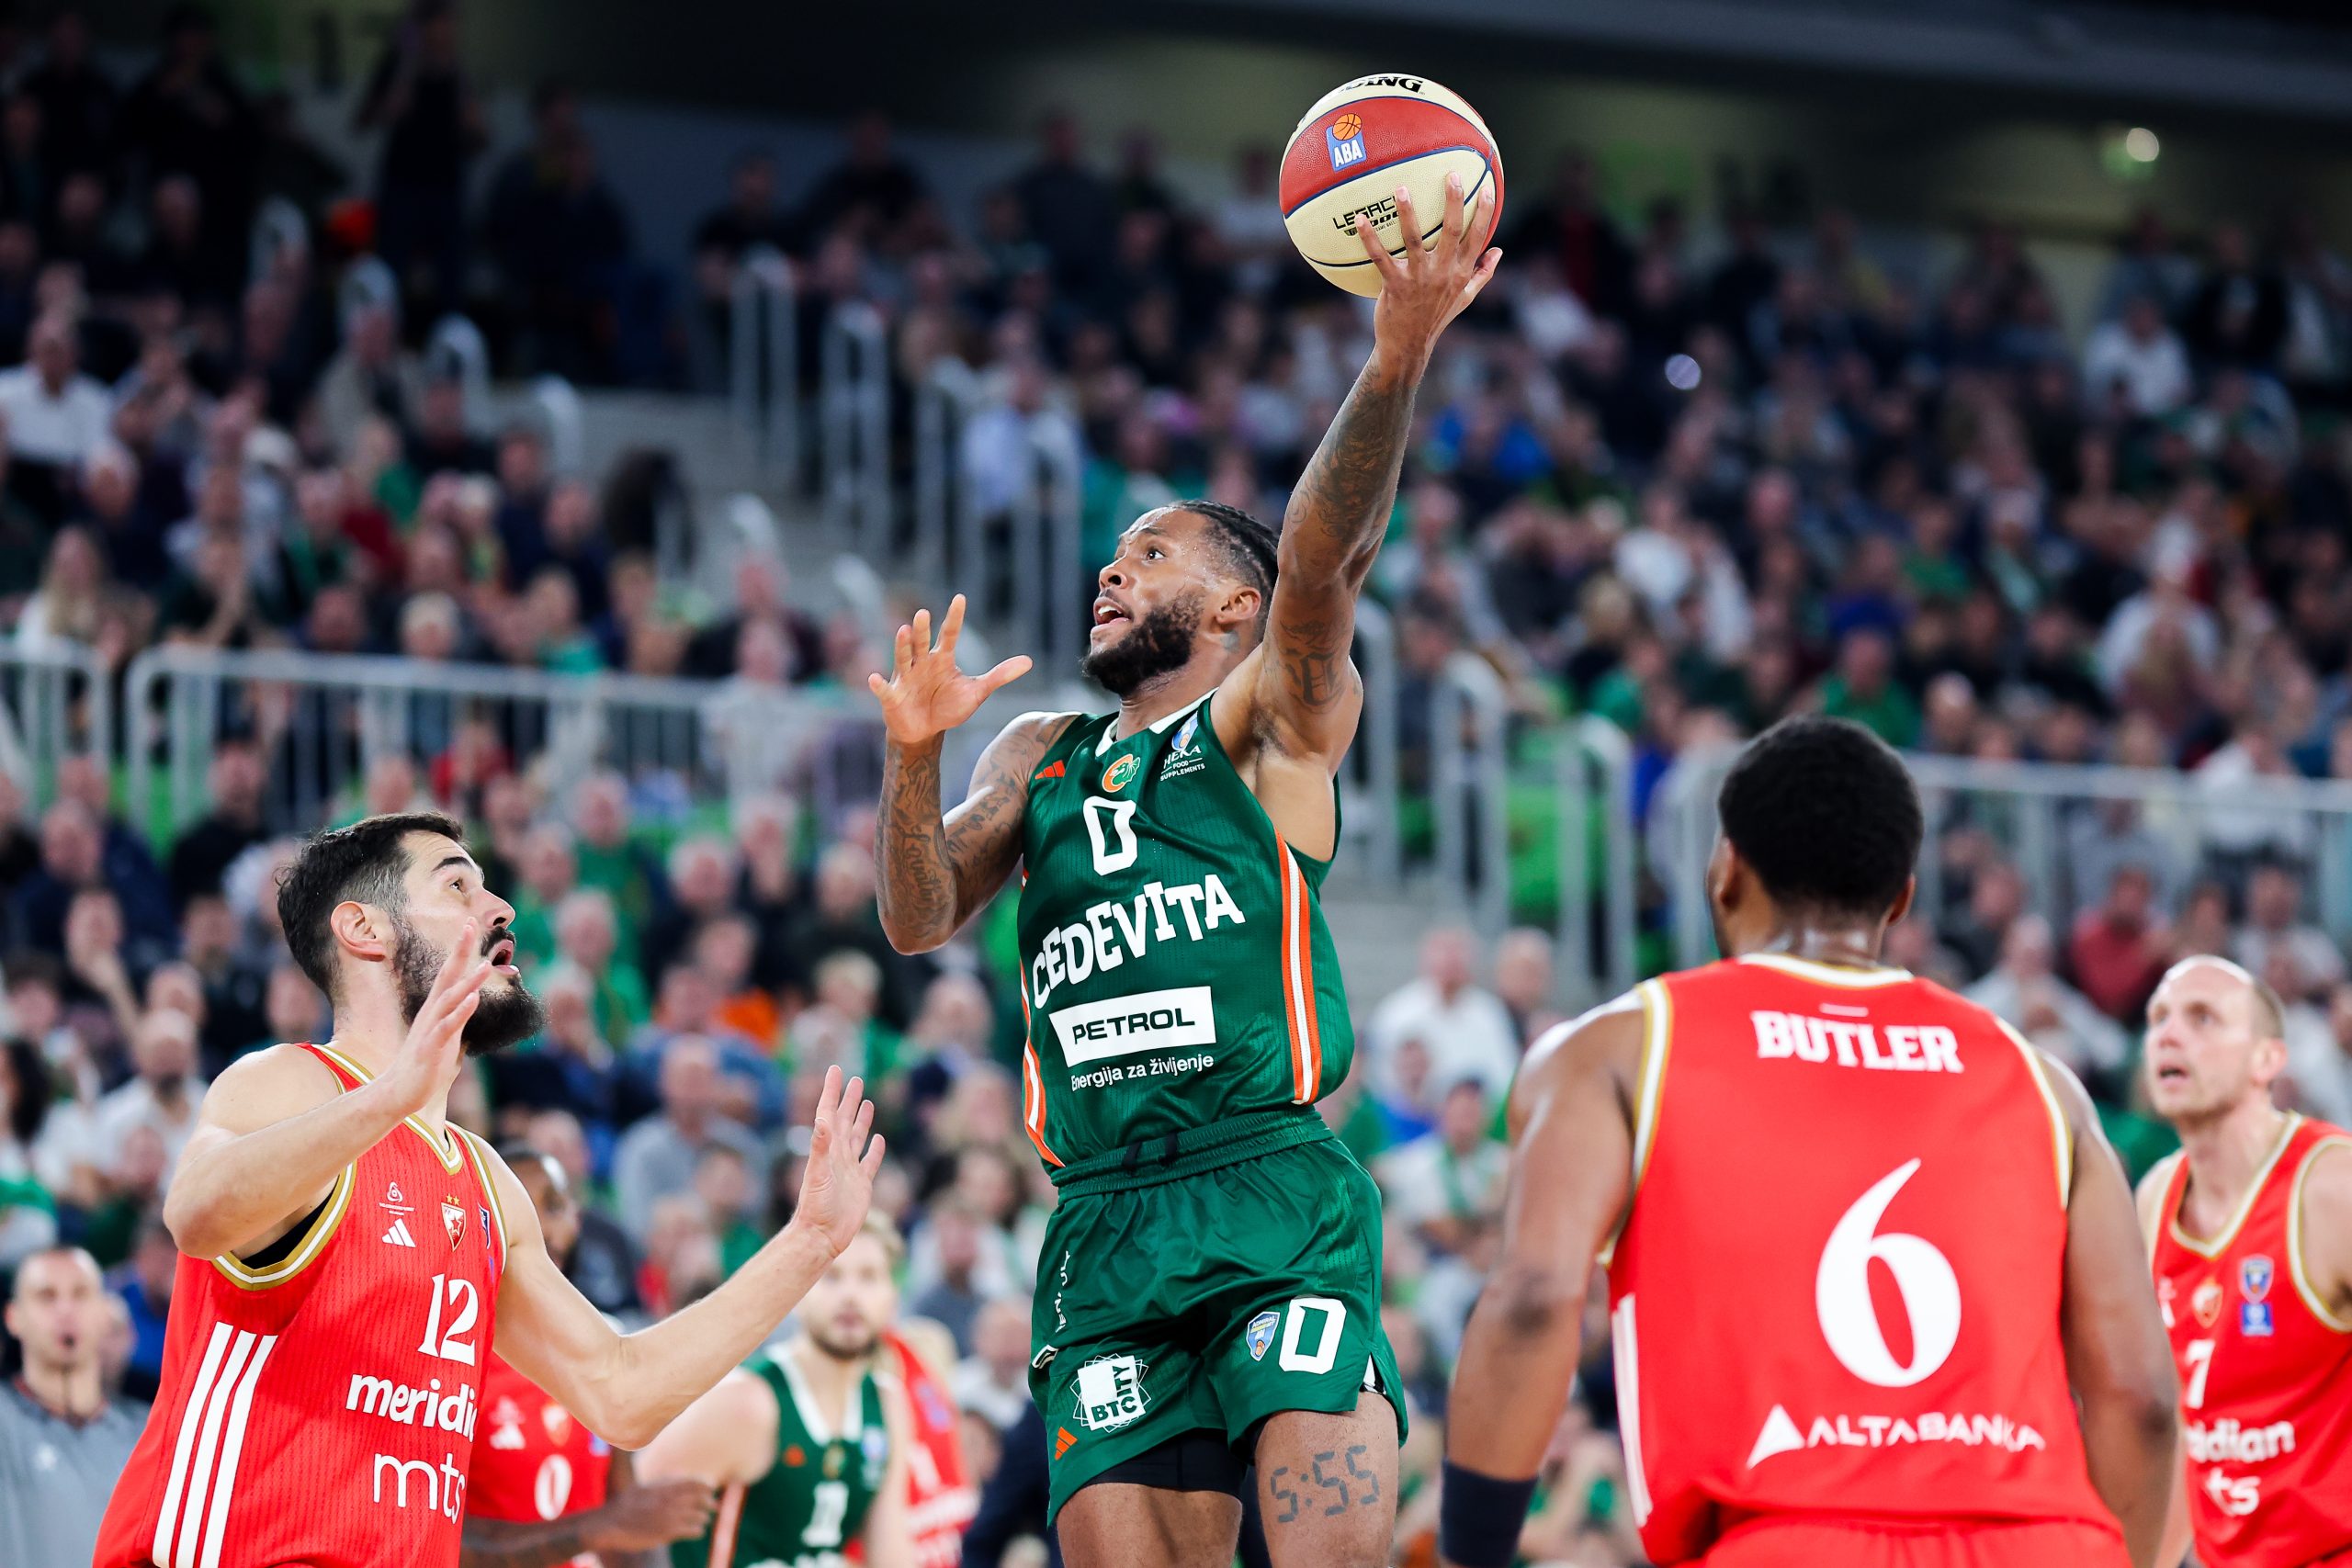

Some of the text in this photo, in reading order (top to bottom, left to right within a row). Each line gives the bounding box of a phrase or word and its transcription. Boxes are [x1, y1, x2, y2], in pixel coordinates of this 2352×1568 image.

[1334, 139, 1363, 167] ABA
[1159, 763, 1205, 782] SUPPLEMENTS
[1172, 760, 1189, 770] FOOD
[1083, 795, 1138, 876] 0
[1032, 874, 1246, 1010] CEDEVITA
[1072, 1008, 1195, 1045] PETROL
[1750, 1010, 1965, 1073] BUTLER
[1070, 1054, 1215, 1092] Energija za življenje
[1815, 1157, 1962, 1388] 6
[417, 1273, 479, 1367] 12
[1279, 1295, 1347, 1375] 0
[1091, 1396, 1137, 1423] BTC
[1807, 1412, 2046, 1452] ALTABANKA
[373, 1452, 466, 1525] mts
[535, 1453, 572, 1521] 0
